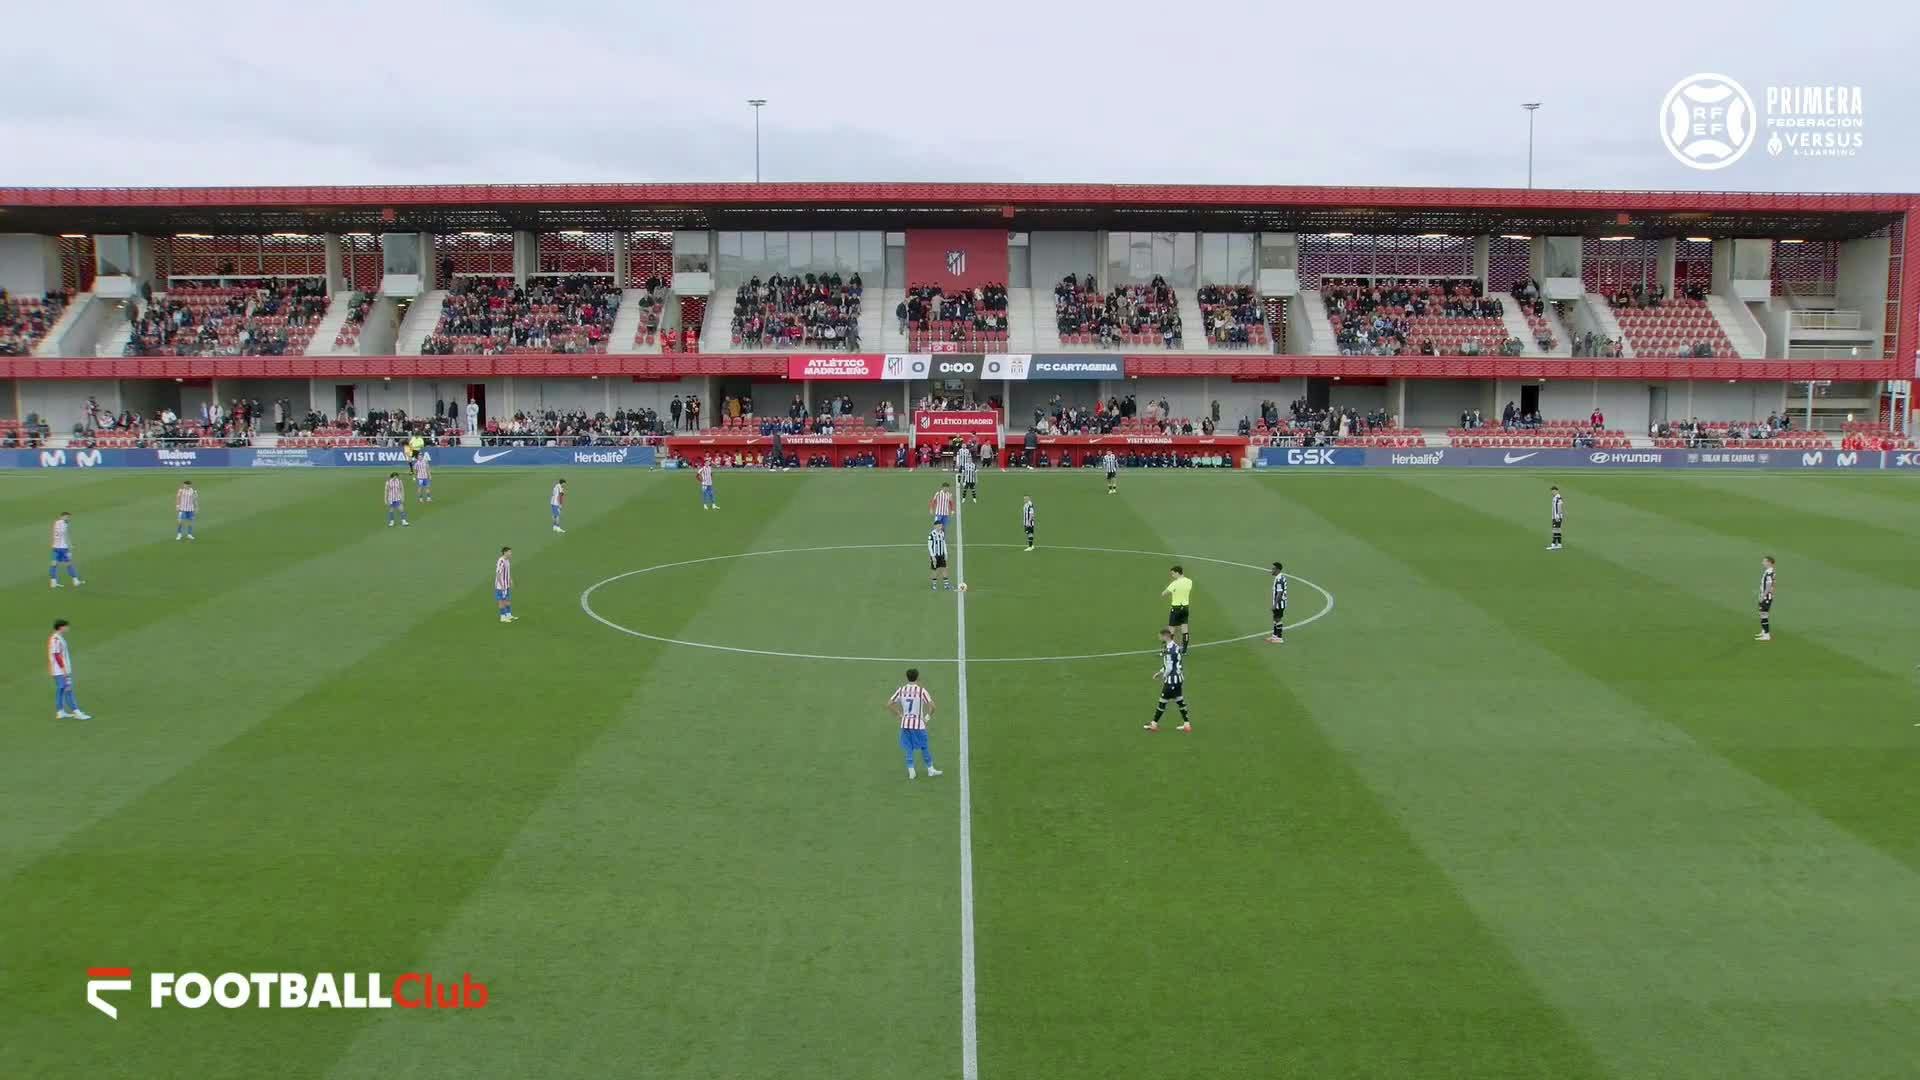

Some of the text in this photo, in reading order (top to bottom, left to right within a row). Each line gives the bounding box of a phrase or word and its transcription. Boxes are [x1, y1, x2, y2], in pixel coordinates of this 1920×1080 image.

[808, 358, 865, 367] ATLÉTICO
[1036, 363, 1118, 371] FC CARTAGENA
[804, 366, 869, 375] MADRILEÑO
[939, 362, 975, 373] 0:00
[933, 417, 962, 425] ATLÉTICO
[344, 452, 431, 461] VISIT RWAA
[575, 451, 624, 463] Herbalife
[1287, 449, 1335, 464] GSK
[1392, 452, 1439, 465] Herbalife
[1611, 454, 1662, 463] HYUNDAI
[906, 699, 914, 713] 7
